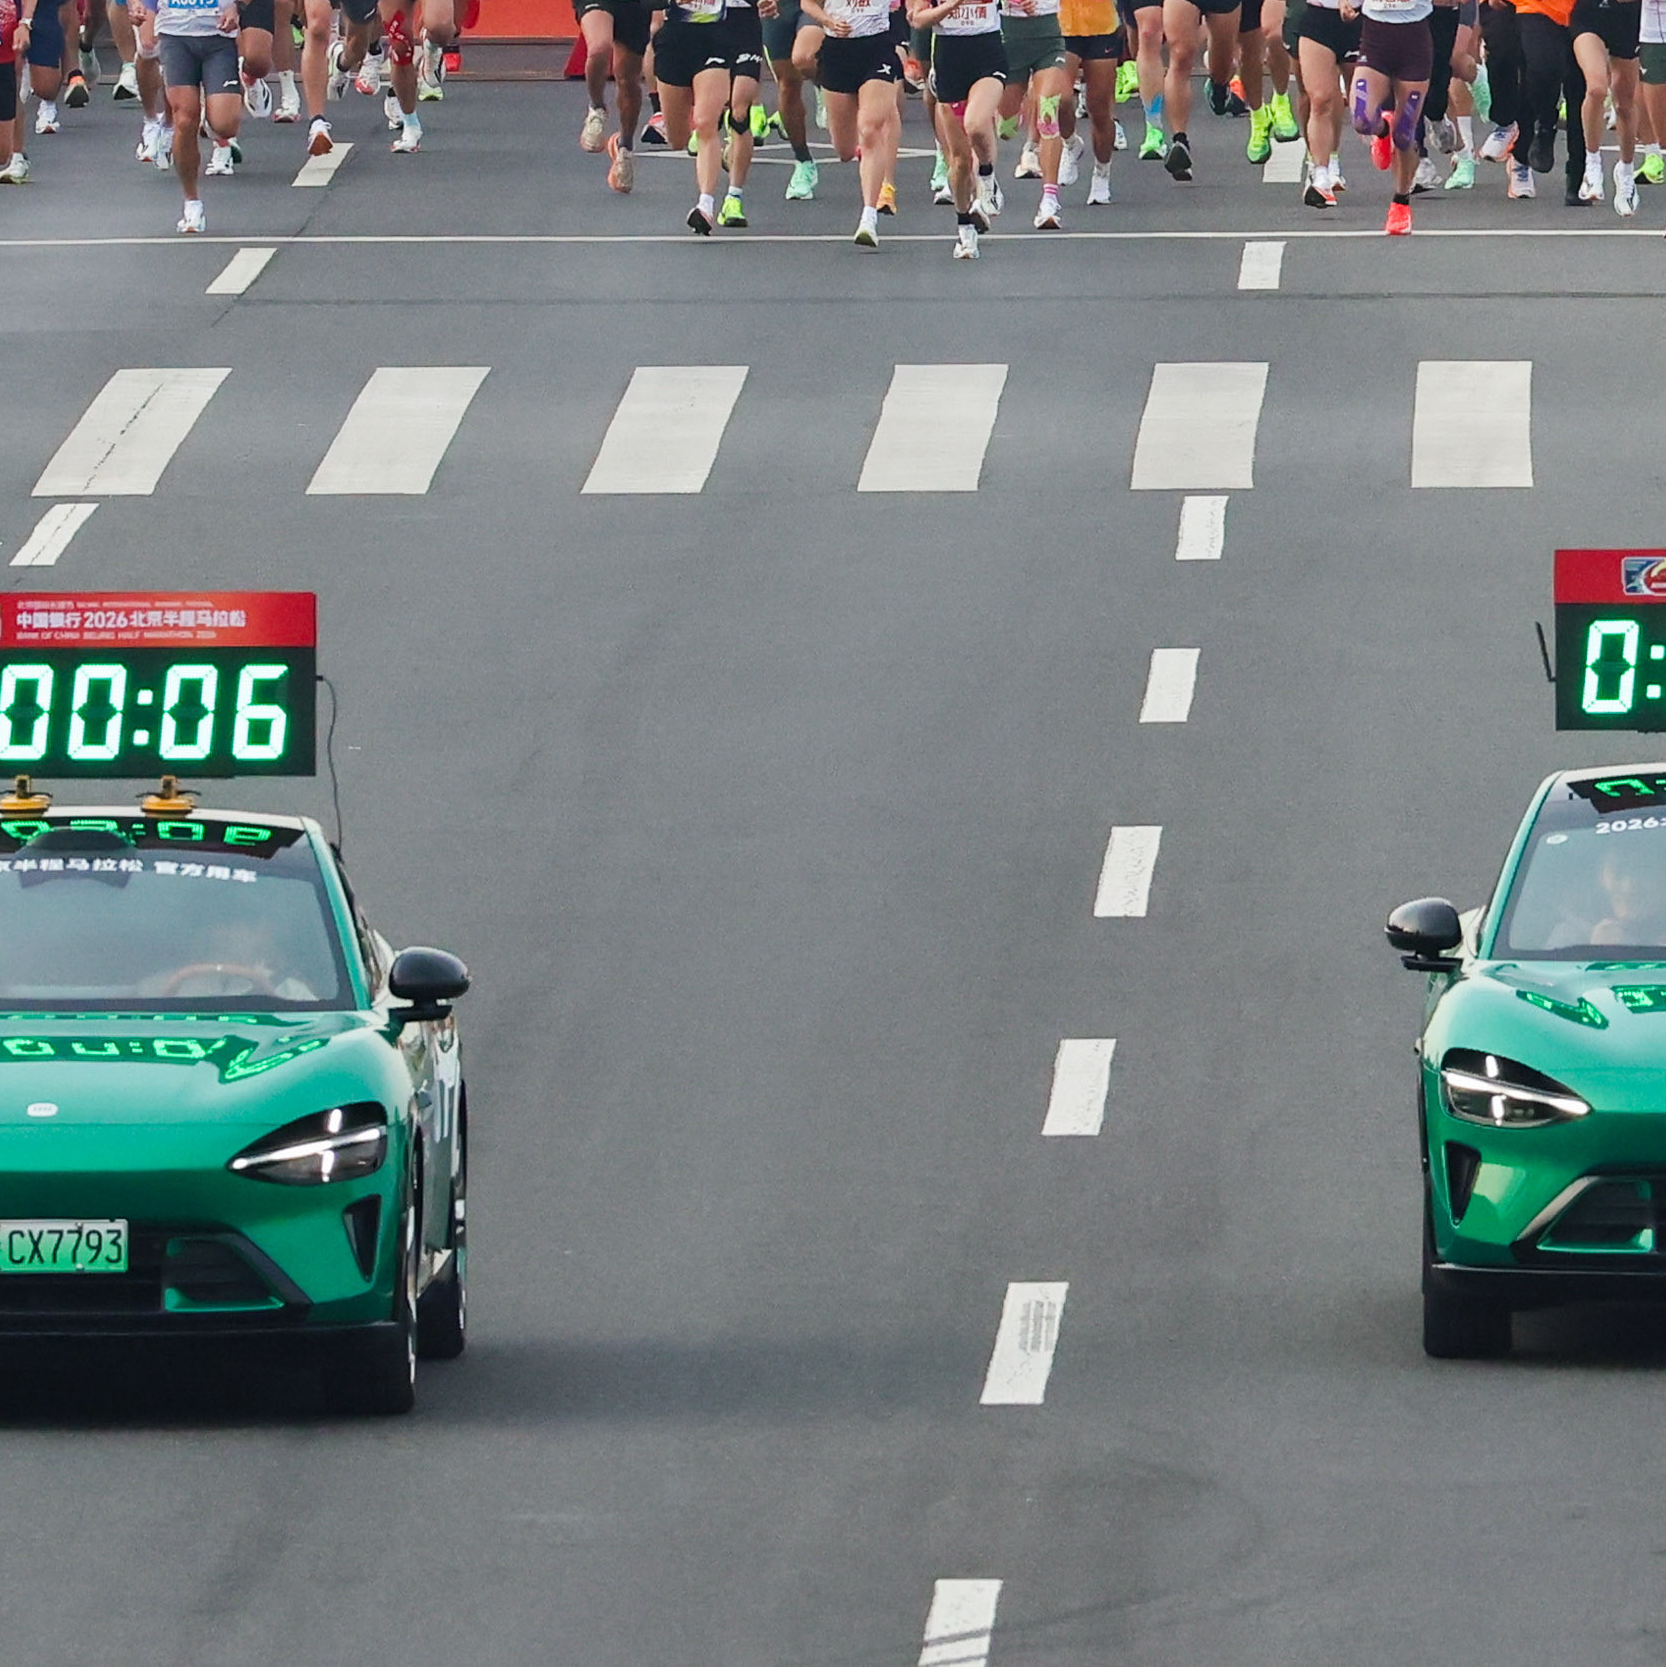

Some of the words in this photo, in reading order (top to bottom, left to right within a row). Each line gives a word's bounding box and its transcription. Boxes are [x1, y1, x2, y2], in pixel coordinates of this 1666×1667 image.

[153, 859, 258, 884] 官方用车
[7, 1228, 123, 1265] CX7793
